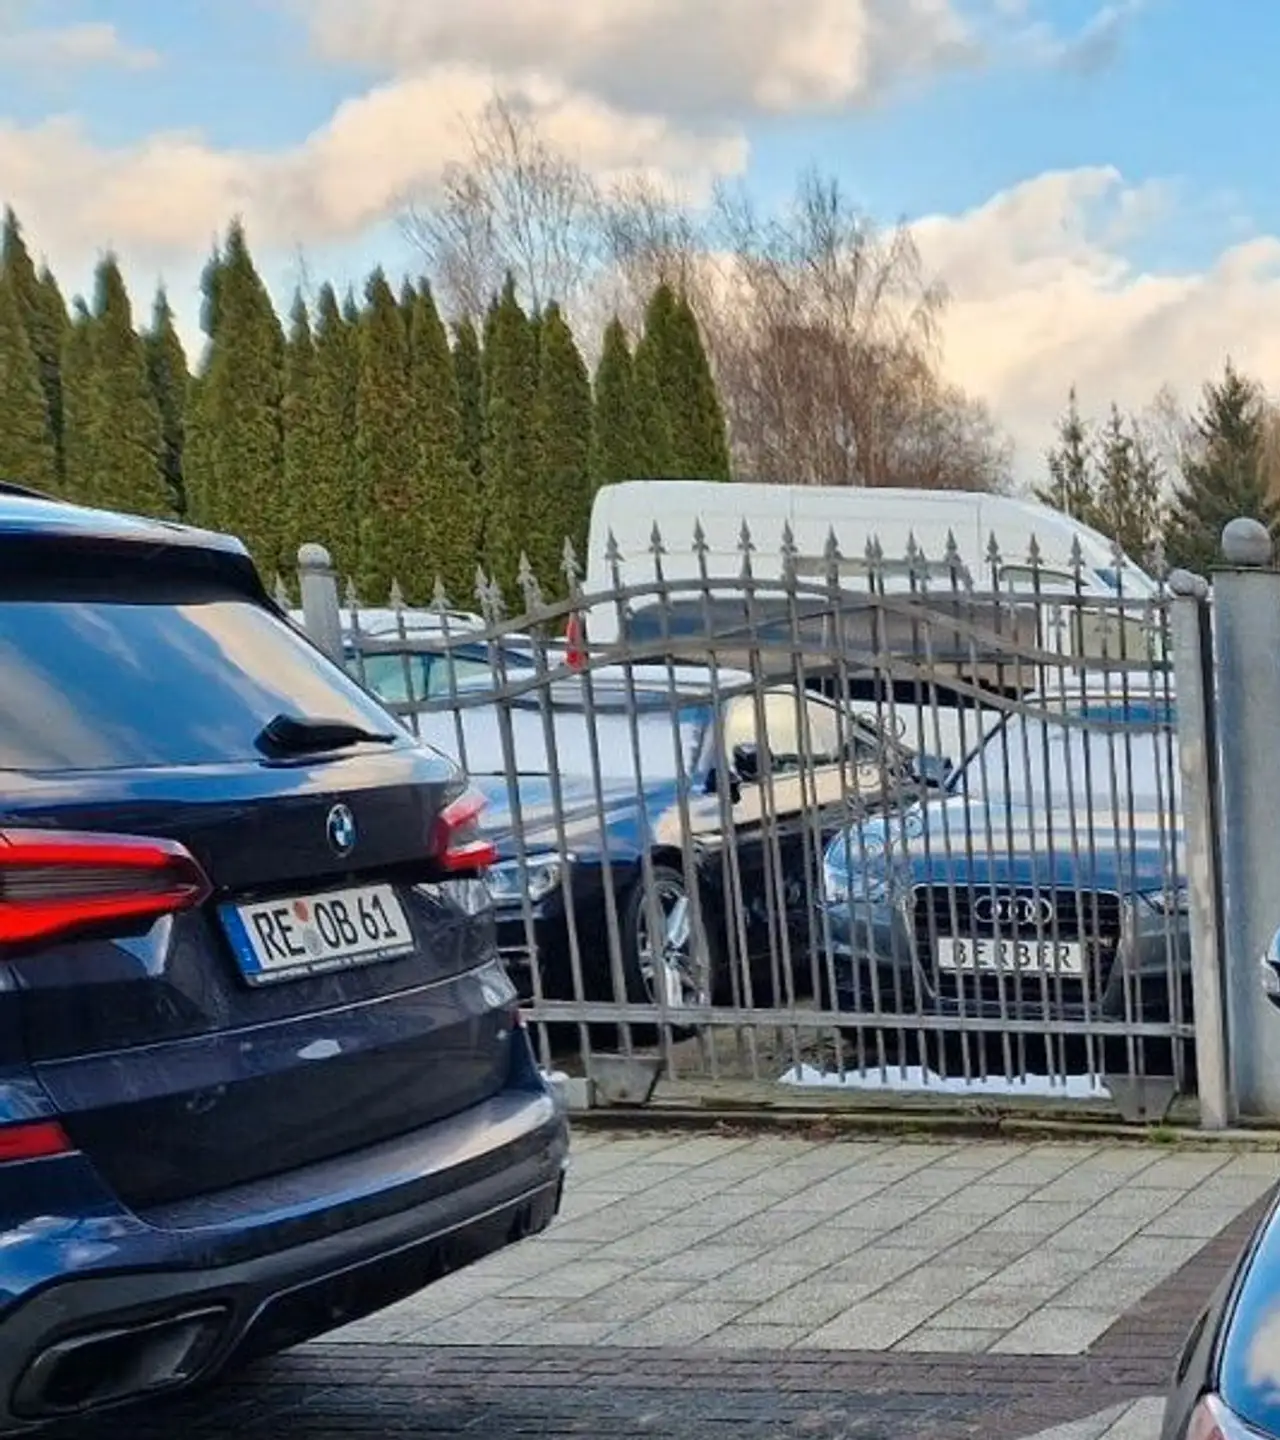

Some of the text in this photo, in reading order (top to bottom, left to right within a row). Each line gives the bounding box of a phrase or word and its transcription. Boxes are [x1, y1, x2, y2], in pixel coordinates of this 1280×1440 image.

[252, 893, 398, 961] RE OB 61
